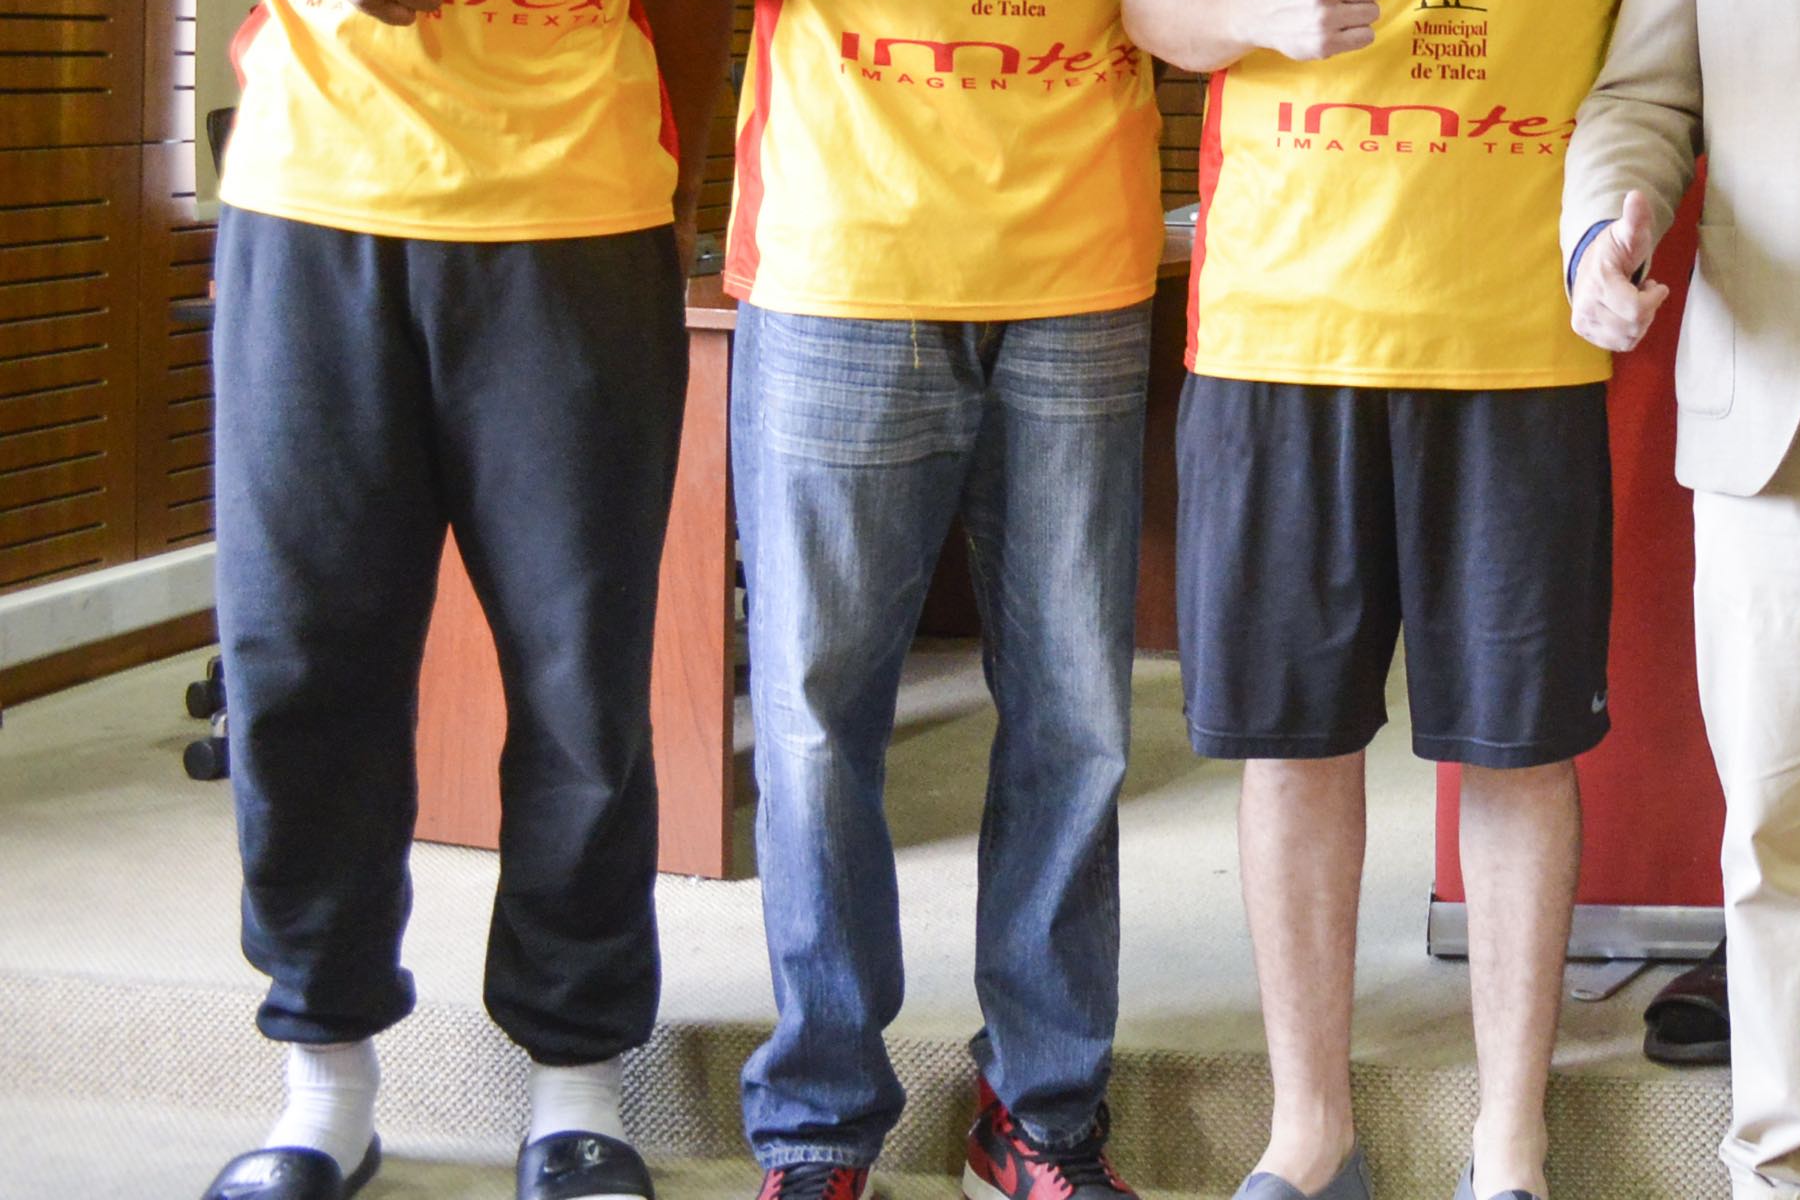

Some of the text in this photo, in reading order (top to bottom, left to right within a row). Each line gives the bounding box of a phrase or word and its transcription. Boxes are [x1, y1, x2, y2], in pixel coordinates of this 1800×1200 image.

[971, 0, 1047, 18] de Talca
[1413, 19, 1488, 39] Municipal
[1411, 38, 1488, 60] Español
[840, 63, 1008, 91] IMAGEN
[1410, 63, 1487, 81] de Talca
[1276, 136, 1570, 155] IMAGEN TEX
